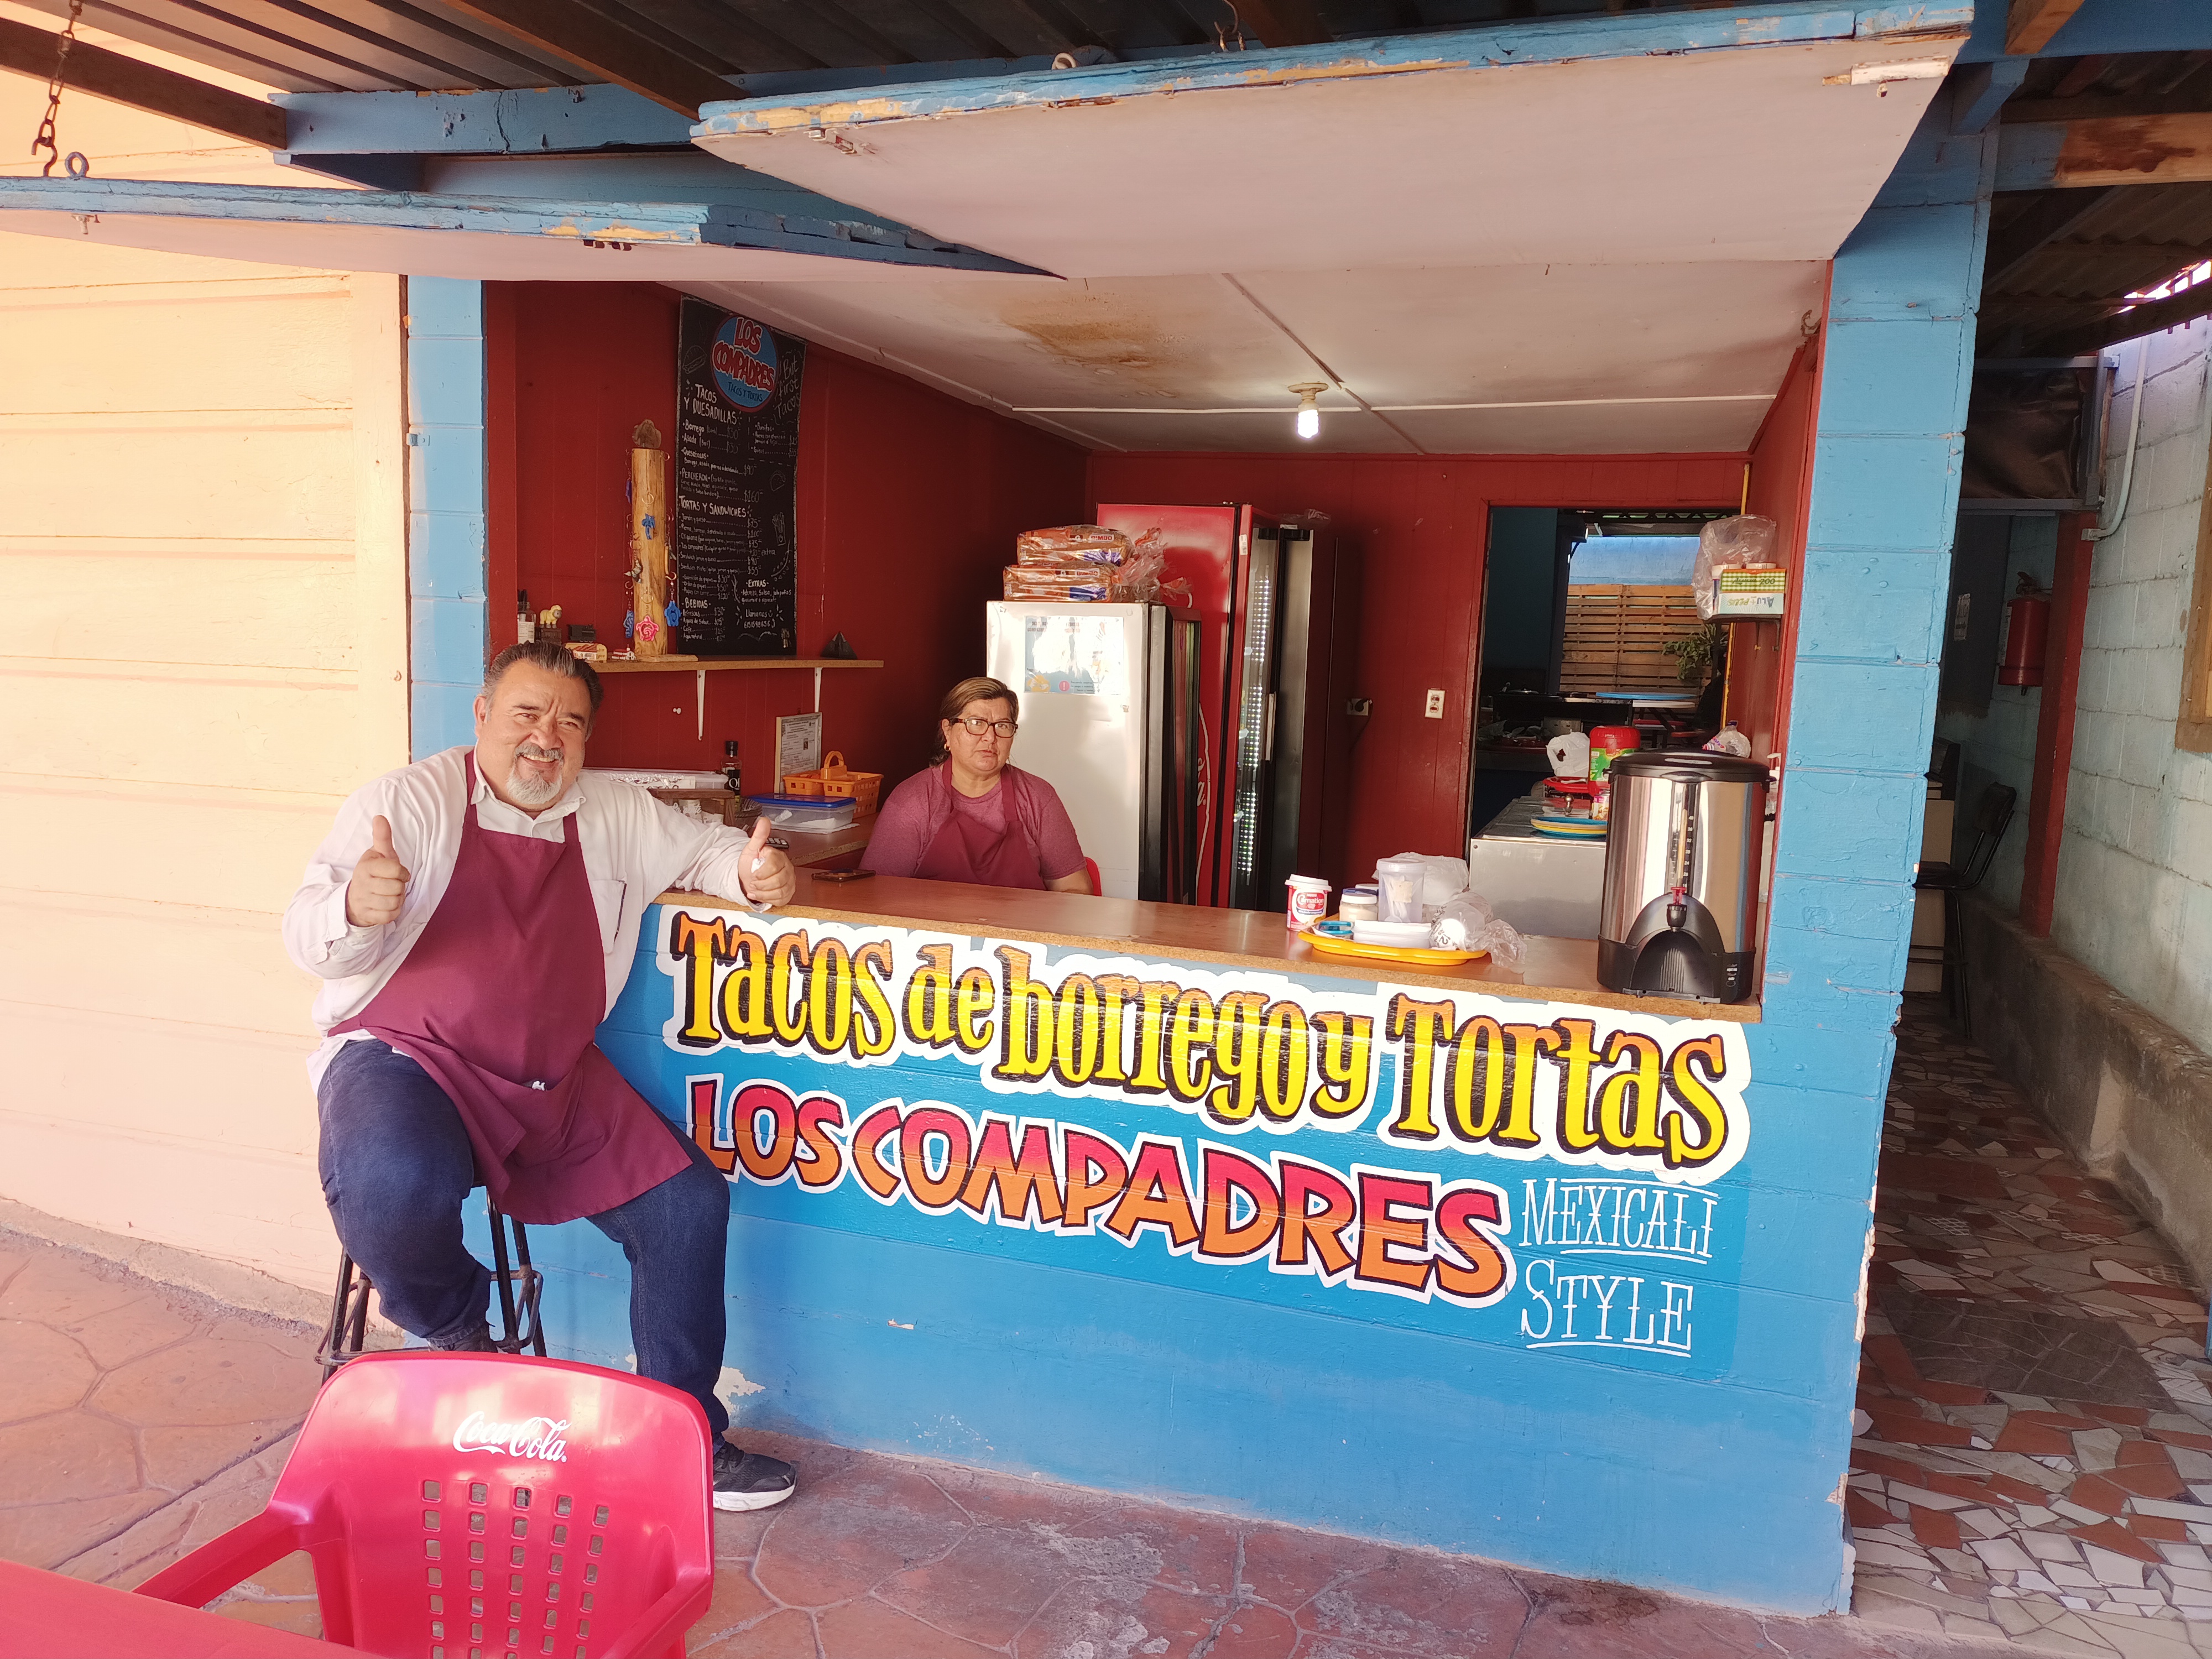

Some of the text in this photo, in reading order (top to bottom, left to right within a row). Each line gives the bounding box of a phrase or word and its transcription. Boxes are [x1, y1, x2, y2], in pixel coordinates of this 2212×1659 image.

[733, 317, 763, 355] LOS
[712, 340, 775, 392] COMPADRES
[695, 383, 717, 404] TACOS
[684, 397, 737, 425] Y QUESADILLAS
[685, 419, 705, 436] Borrego
[679, 495, 747, 518] TORTAS Y SANDWICHES
[748, 579, 766, 587] EXTRAS
[685, 597, 708, 608] BEBIDAS
[671, 911, 1729, 1169] Tacos de borrego y Tortas
[691, 1079, 1507, 1298] LOS COMPADRES
[1519, 1178, 1718, 1258] MEXICALI
[1520, 1259, 1694, 1351] STYLE
